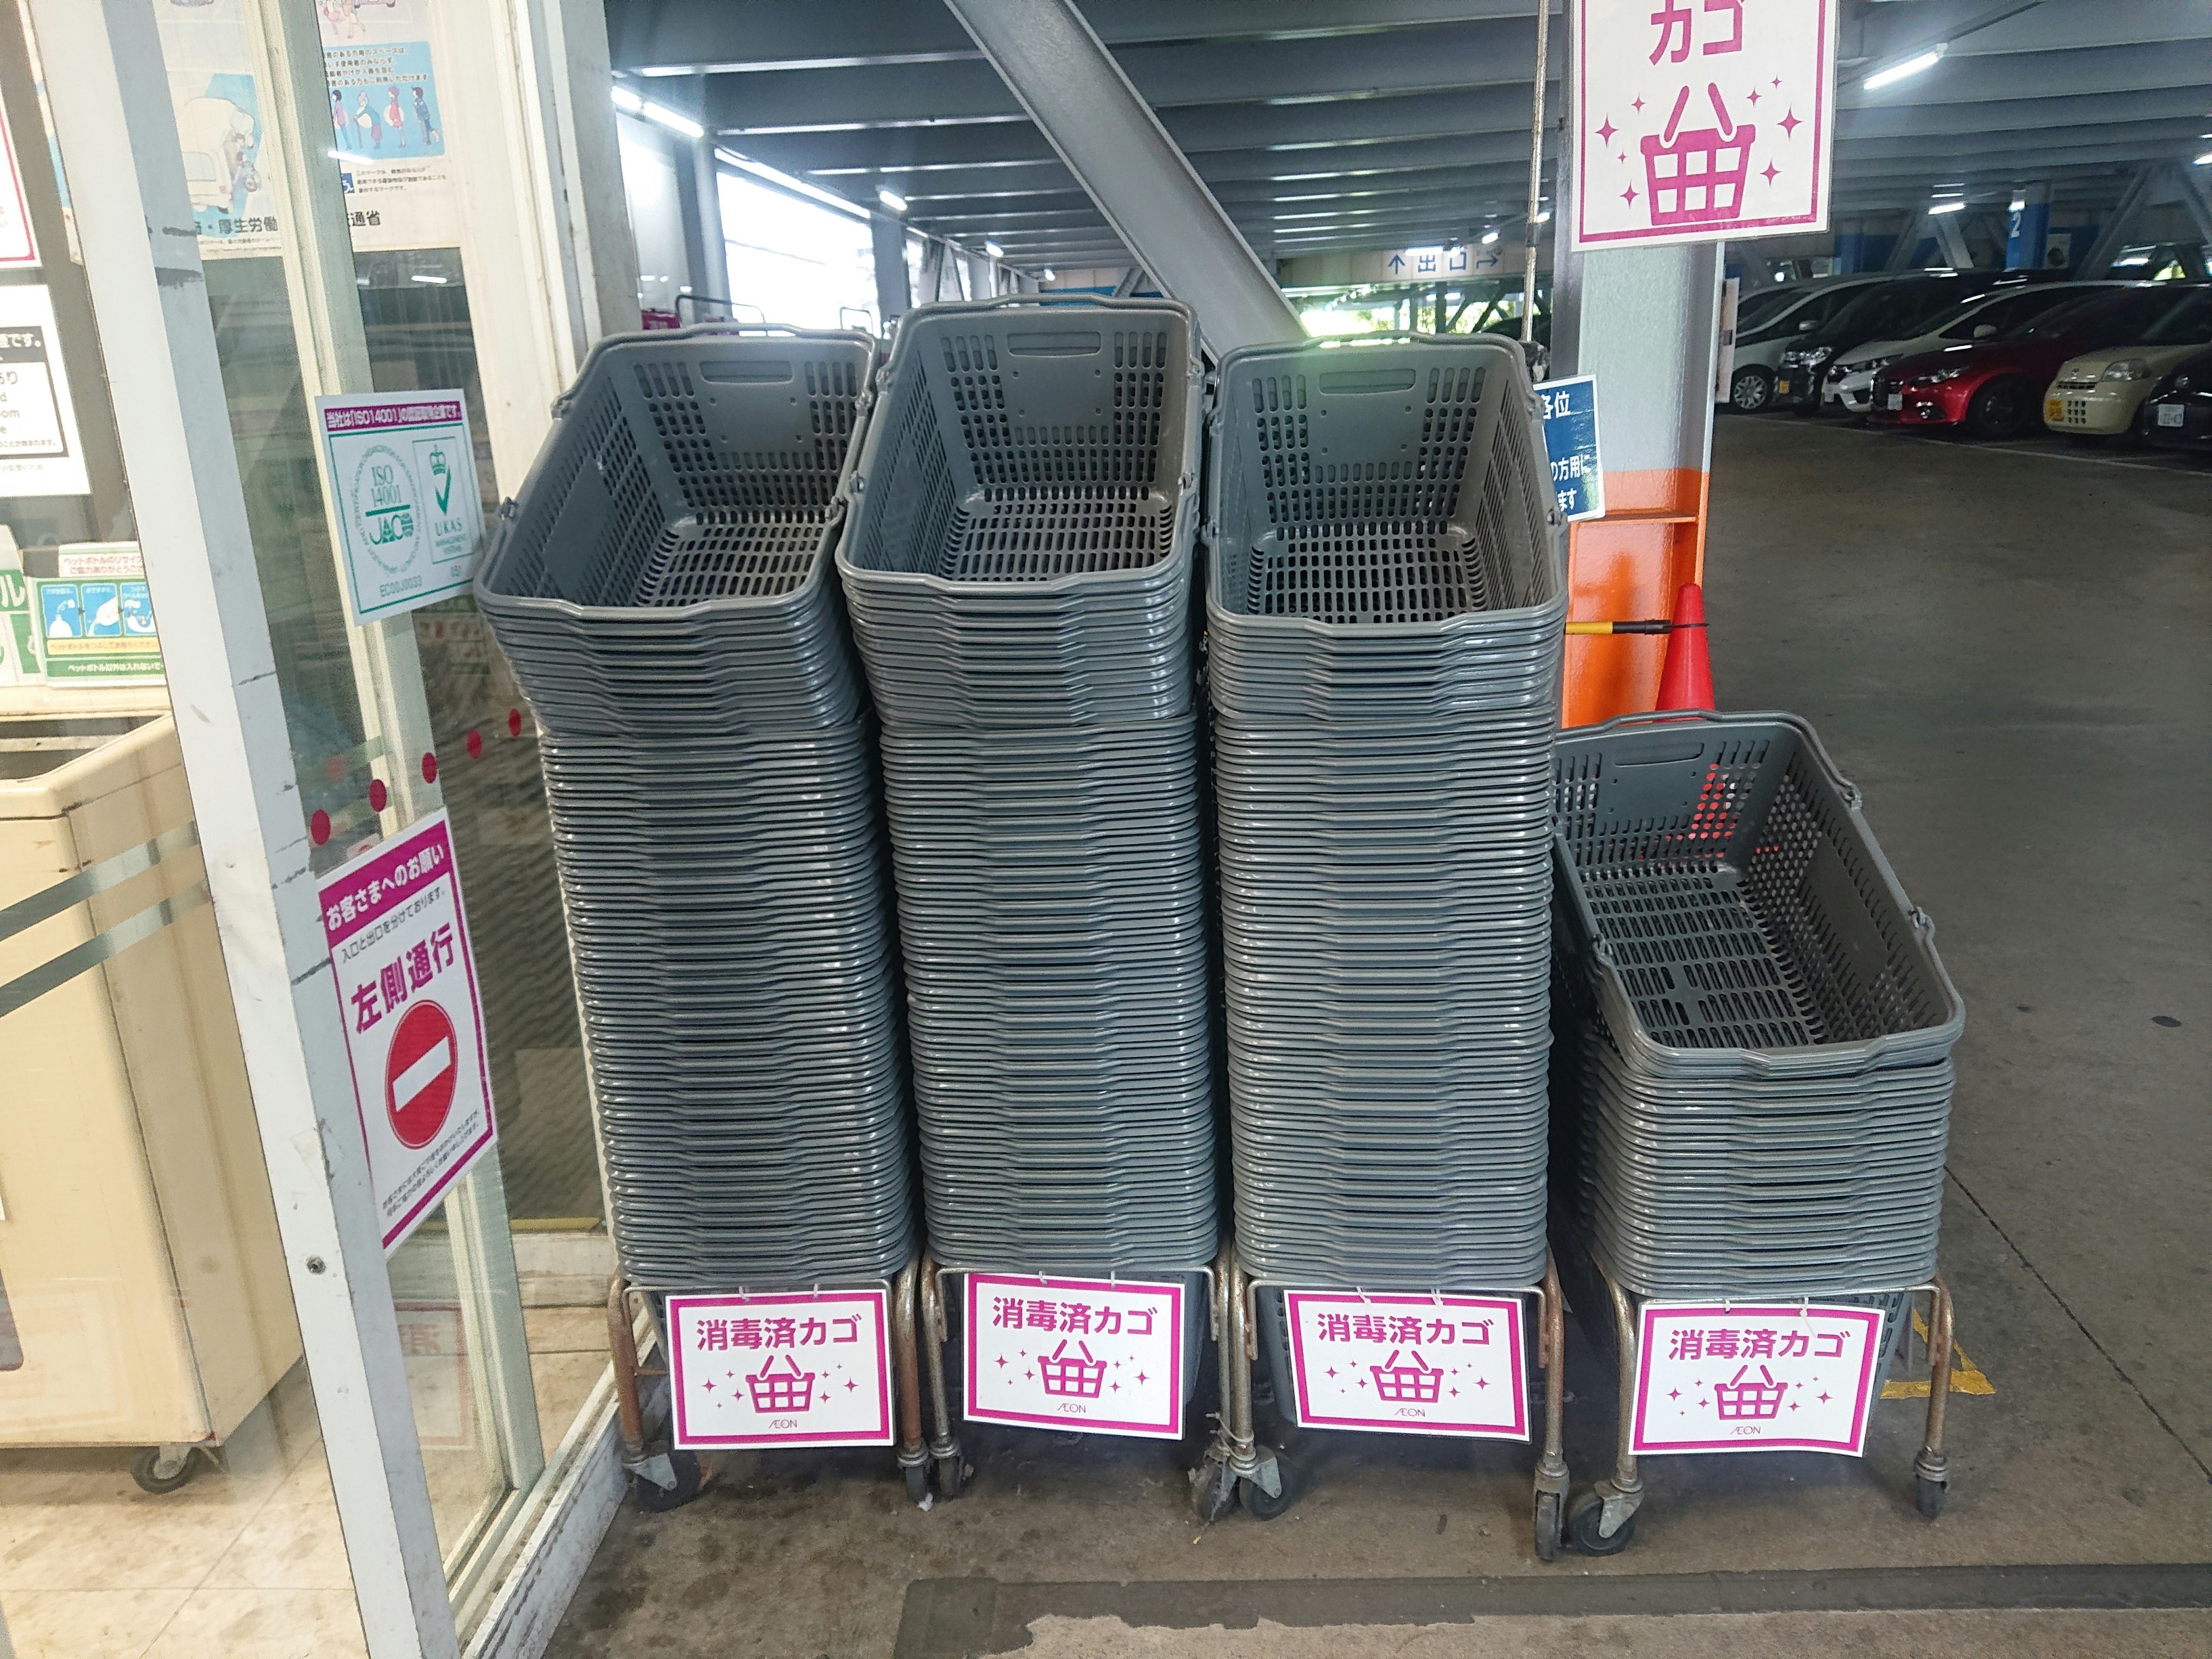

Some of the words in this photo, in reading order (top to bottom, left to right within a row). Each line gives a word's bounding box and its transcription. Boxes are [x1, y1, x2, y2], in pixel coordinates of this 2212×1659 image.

[2009, 212, 2021, 238] 2
[1417, 252, 1467, 272] 出口
[372, 465, 394, 487] ISO
[371, 484, 402, 507] 14001
[435, 518, 462, 537] UKAS
[326, 844, 445, 931] お客さまへのお願い
[351, 922, 454, 1034] 左側通行
[993, 1296, 1158, 1335] 消毒済カゴ
[1317, 1312, 1494, 1345] 消毒済カゴ
[696, 1313, 862, 1352] 消毒済カゴ
[1668, 1328, 1851, 1360] 消毒済カゴ
